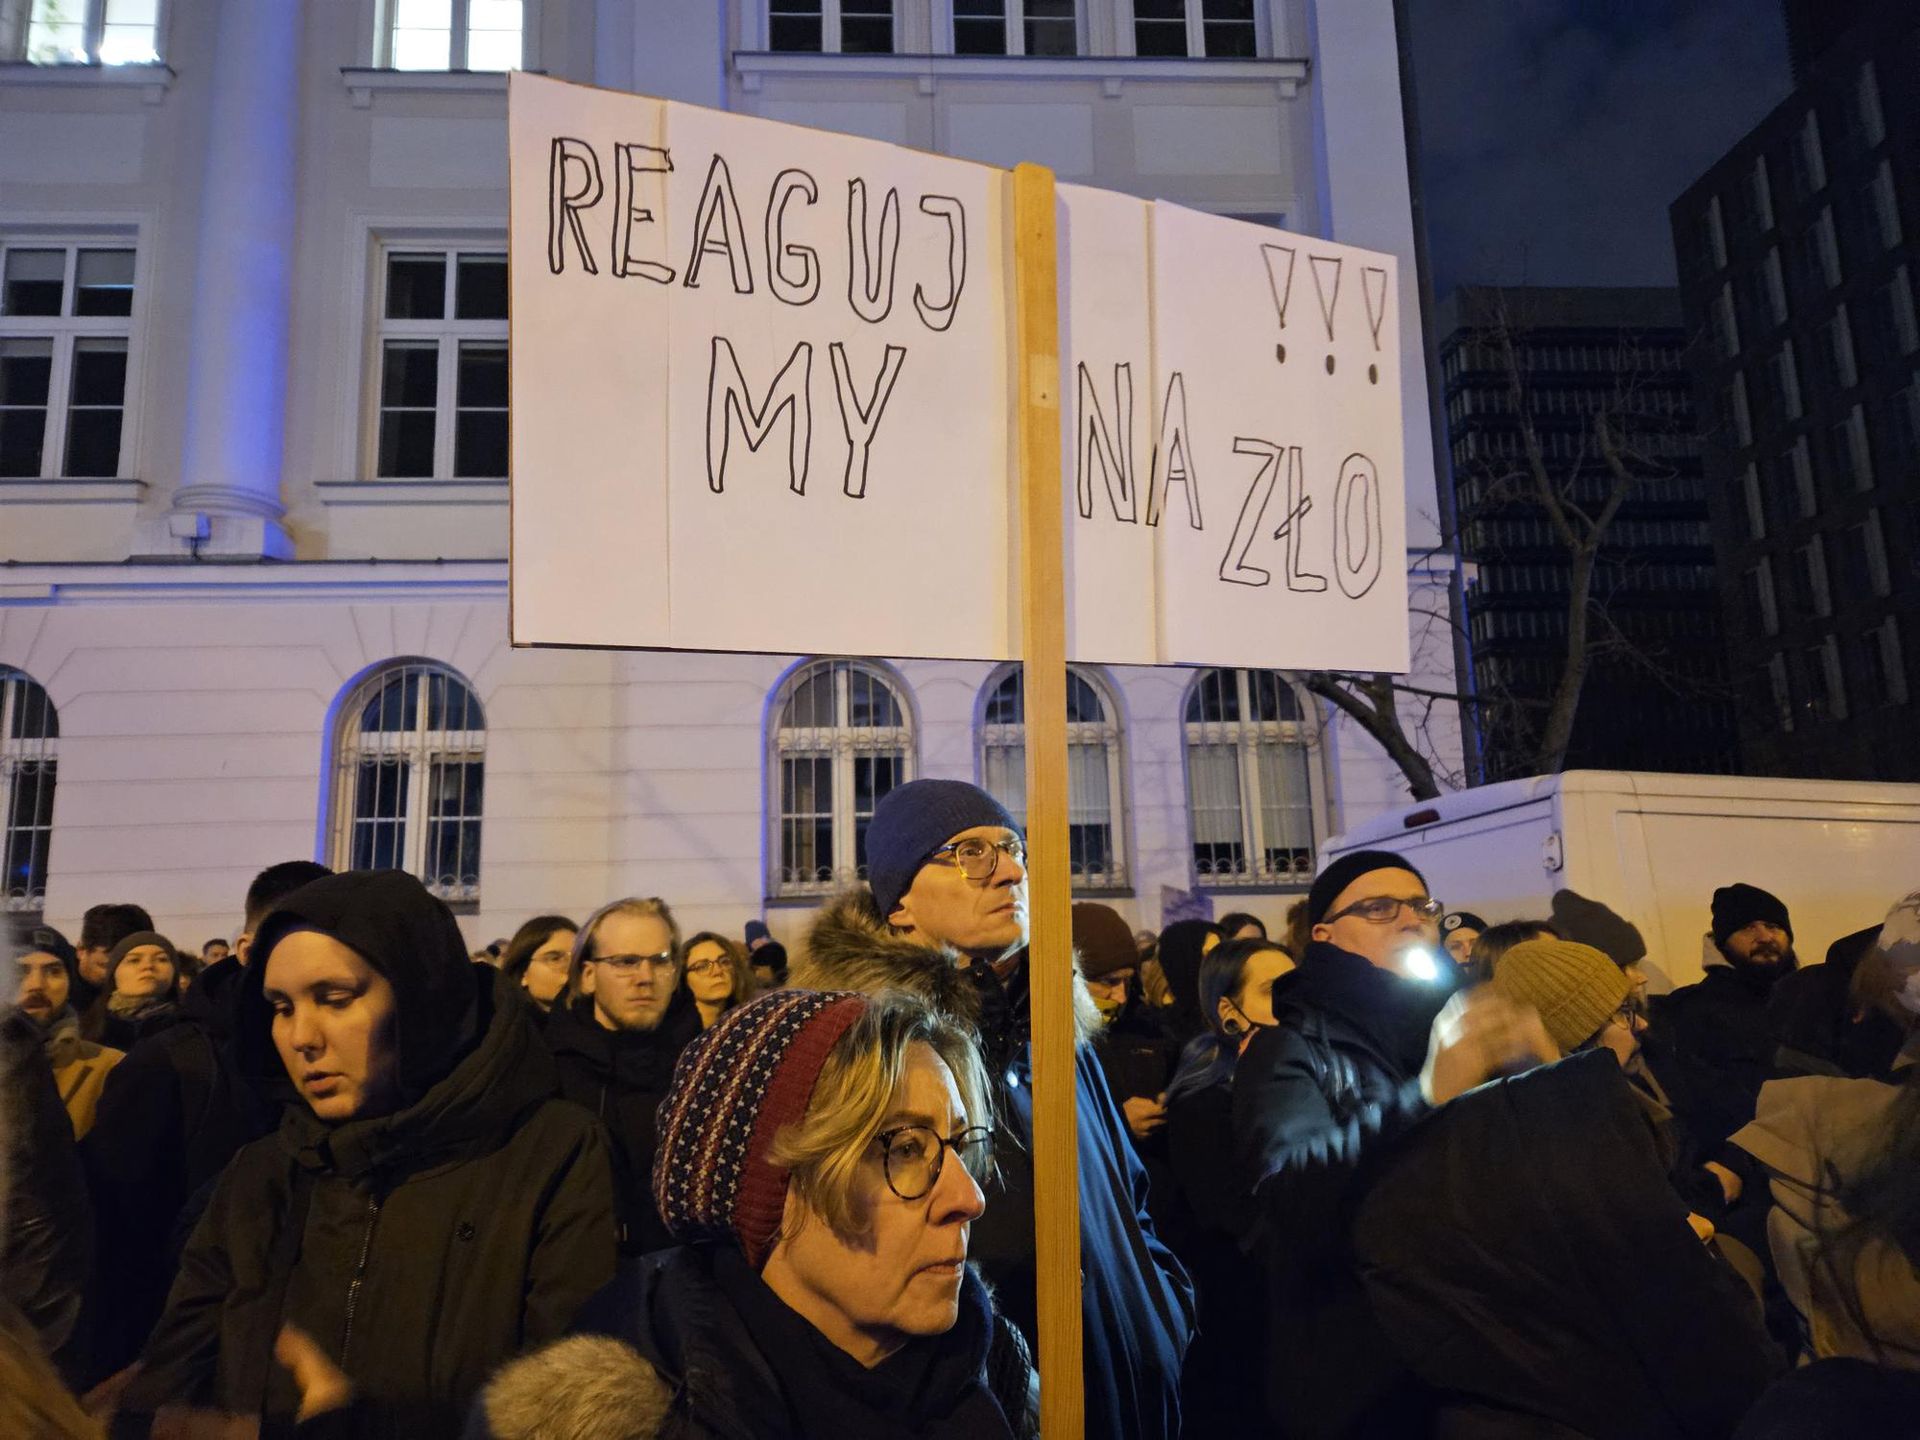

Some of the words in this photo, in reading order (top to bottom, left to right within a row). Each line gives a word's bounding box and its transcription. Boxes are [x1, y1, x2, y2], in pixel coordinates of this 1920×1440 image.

[548, 137, 967, 331] REAGUJ
[1260, 243, 1387, 385] !!!
[706, 336, 907, 499] MY
[1077, 361, 1203, 530] NA
[1219, 436, 1382, 599] ZŁO
